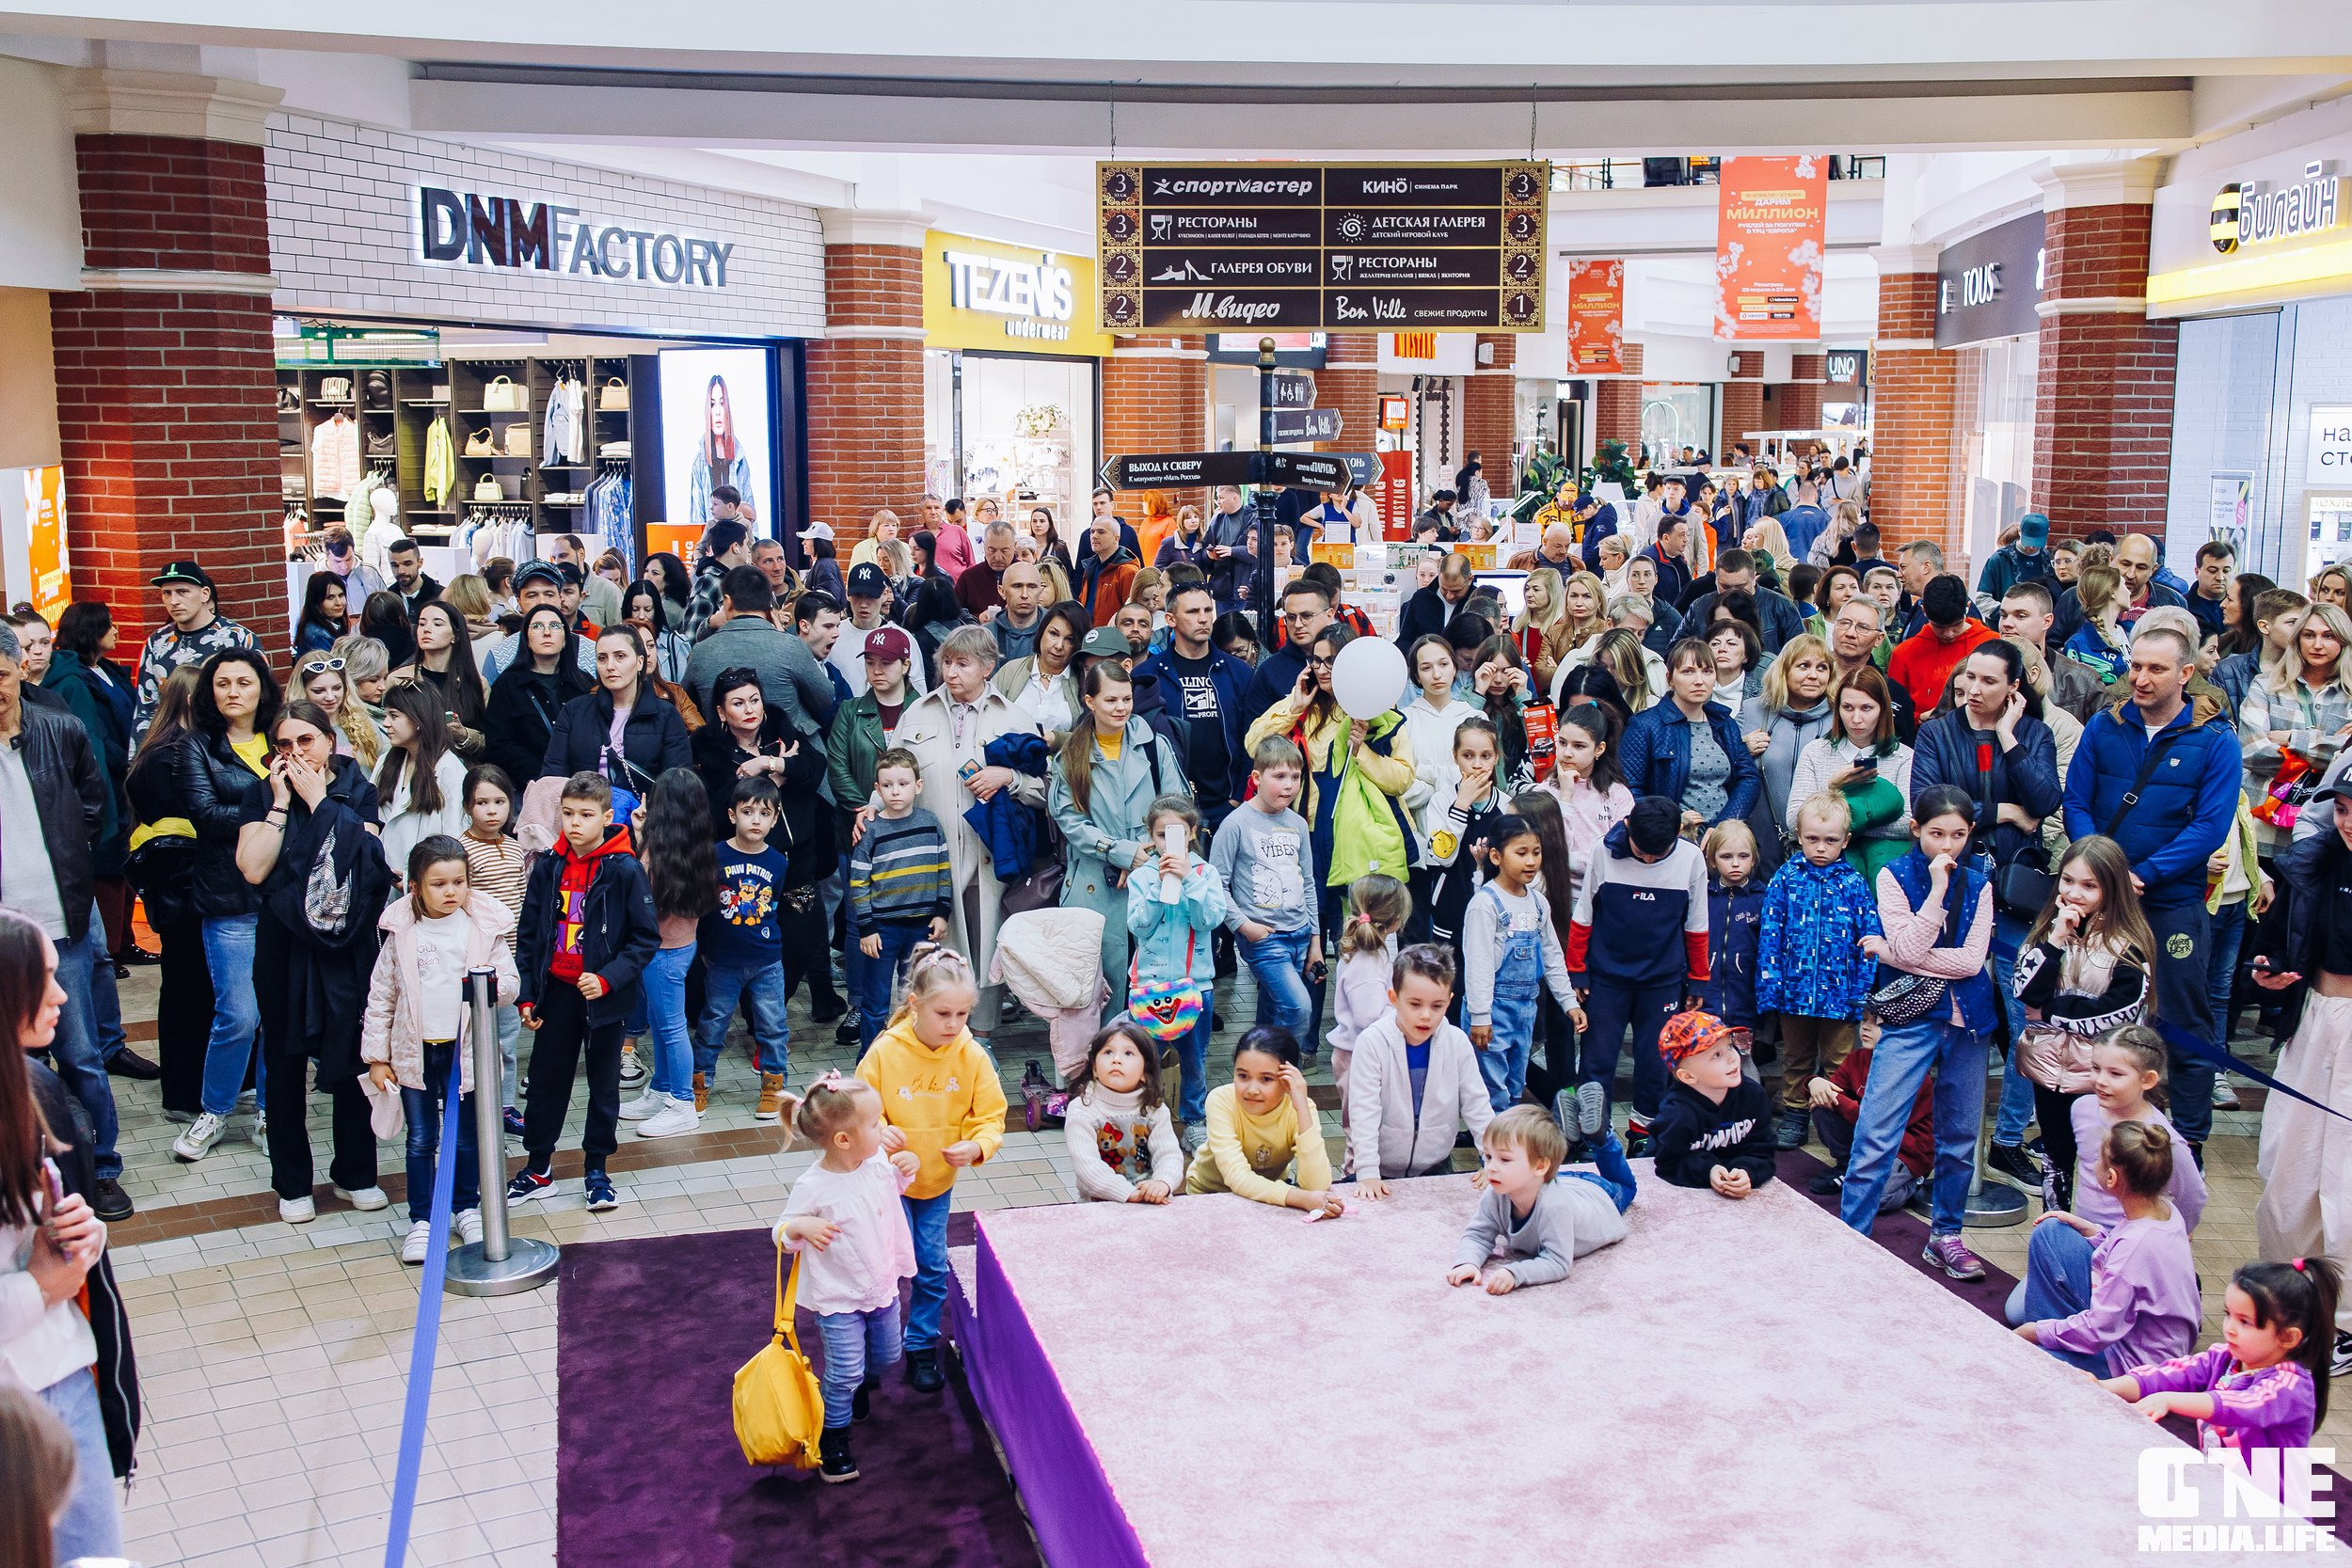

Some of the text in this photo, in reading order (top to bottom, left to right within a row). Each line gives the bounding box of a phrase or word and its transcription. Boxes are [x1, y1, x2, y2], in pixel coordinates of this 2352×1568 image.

[1115, 173, 1127, 194] 3
[1517, 174, 1529, 194] 3
[1755, 198, 1791, 206] ДАРИМ
[1115, 214, 1127, 233] 3
[1178, 216, 1257, 228] РЕСТОРАНЫ
[1372, 216, 1486, 229] ДЕТСКАЯ ГАЛЕРЕЯ
[1517, 214, 1529, 233] 3
[1726, 208, 1819, 220] МИЛЛИОН
[1372, 230, 1401, 239] ДЕТСКИЙ
[549, 204, 735, 288] FACTORY
[1115, 255, 1127, 275] 2
[1211, 262, 1312, 274] ГАЛЕРЕЯ ОБУВИ
[1359, 257, 1438, 268] РЕСТОРАНЫ
[1515, 254, 1528, 274] 2
[1963, 261, 1994, 308] TOUS
[1115, 295, 1127, 314] 2
[1182, 293, 1280, 324] М.видео
[1335, 295, 1407, 321] Bon Ville
[1515, 294, 1525, 313] 1
[1447, 309, 1487, 319] ПРОДУКТЫ
[1006, 317, 1071, 341] underwear
[1828, 356, 1856, 375] UNQ
[1129, 461, 1202, 472] ВЫХОД К СКВЕРУ
[1392, 478, 1406, 529] MUSTANG
[858, 567, 872, 580] NY
[871, 632, 886, 645] NY
[1261, 835, 1293, 847] BIG CITY
[1261, 844, 1295, 858] VIBES
[724, 863, 773, 883] PAW PATROL
[1632, 891, 1656, 901] FILA
